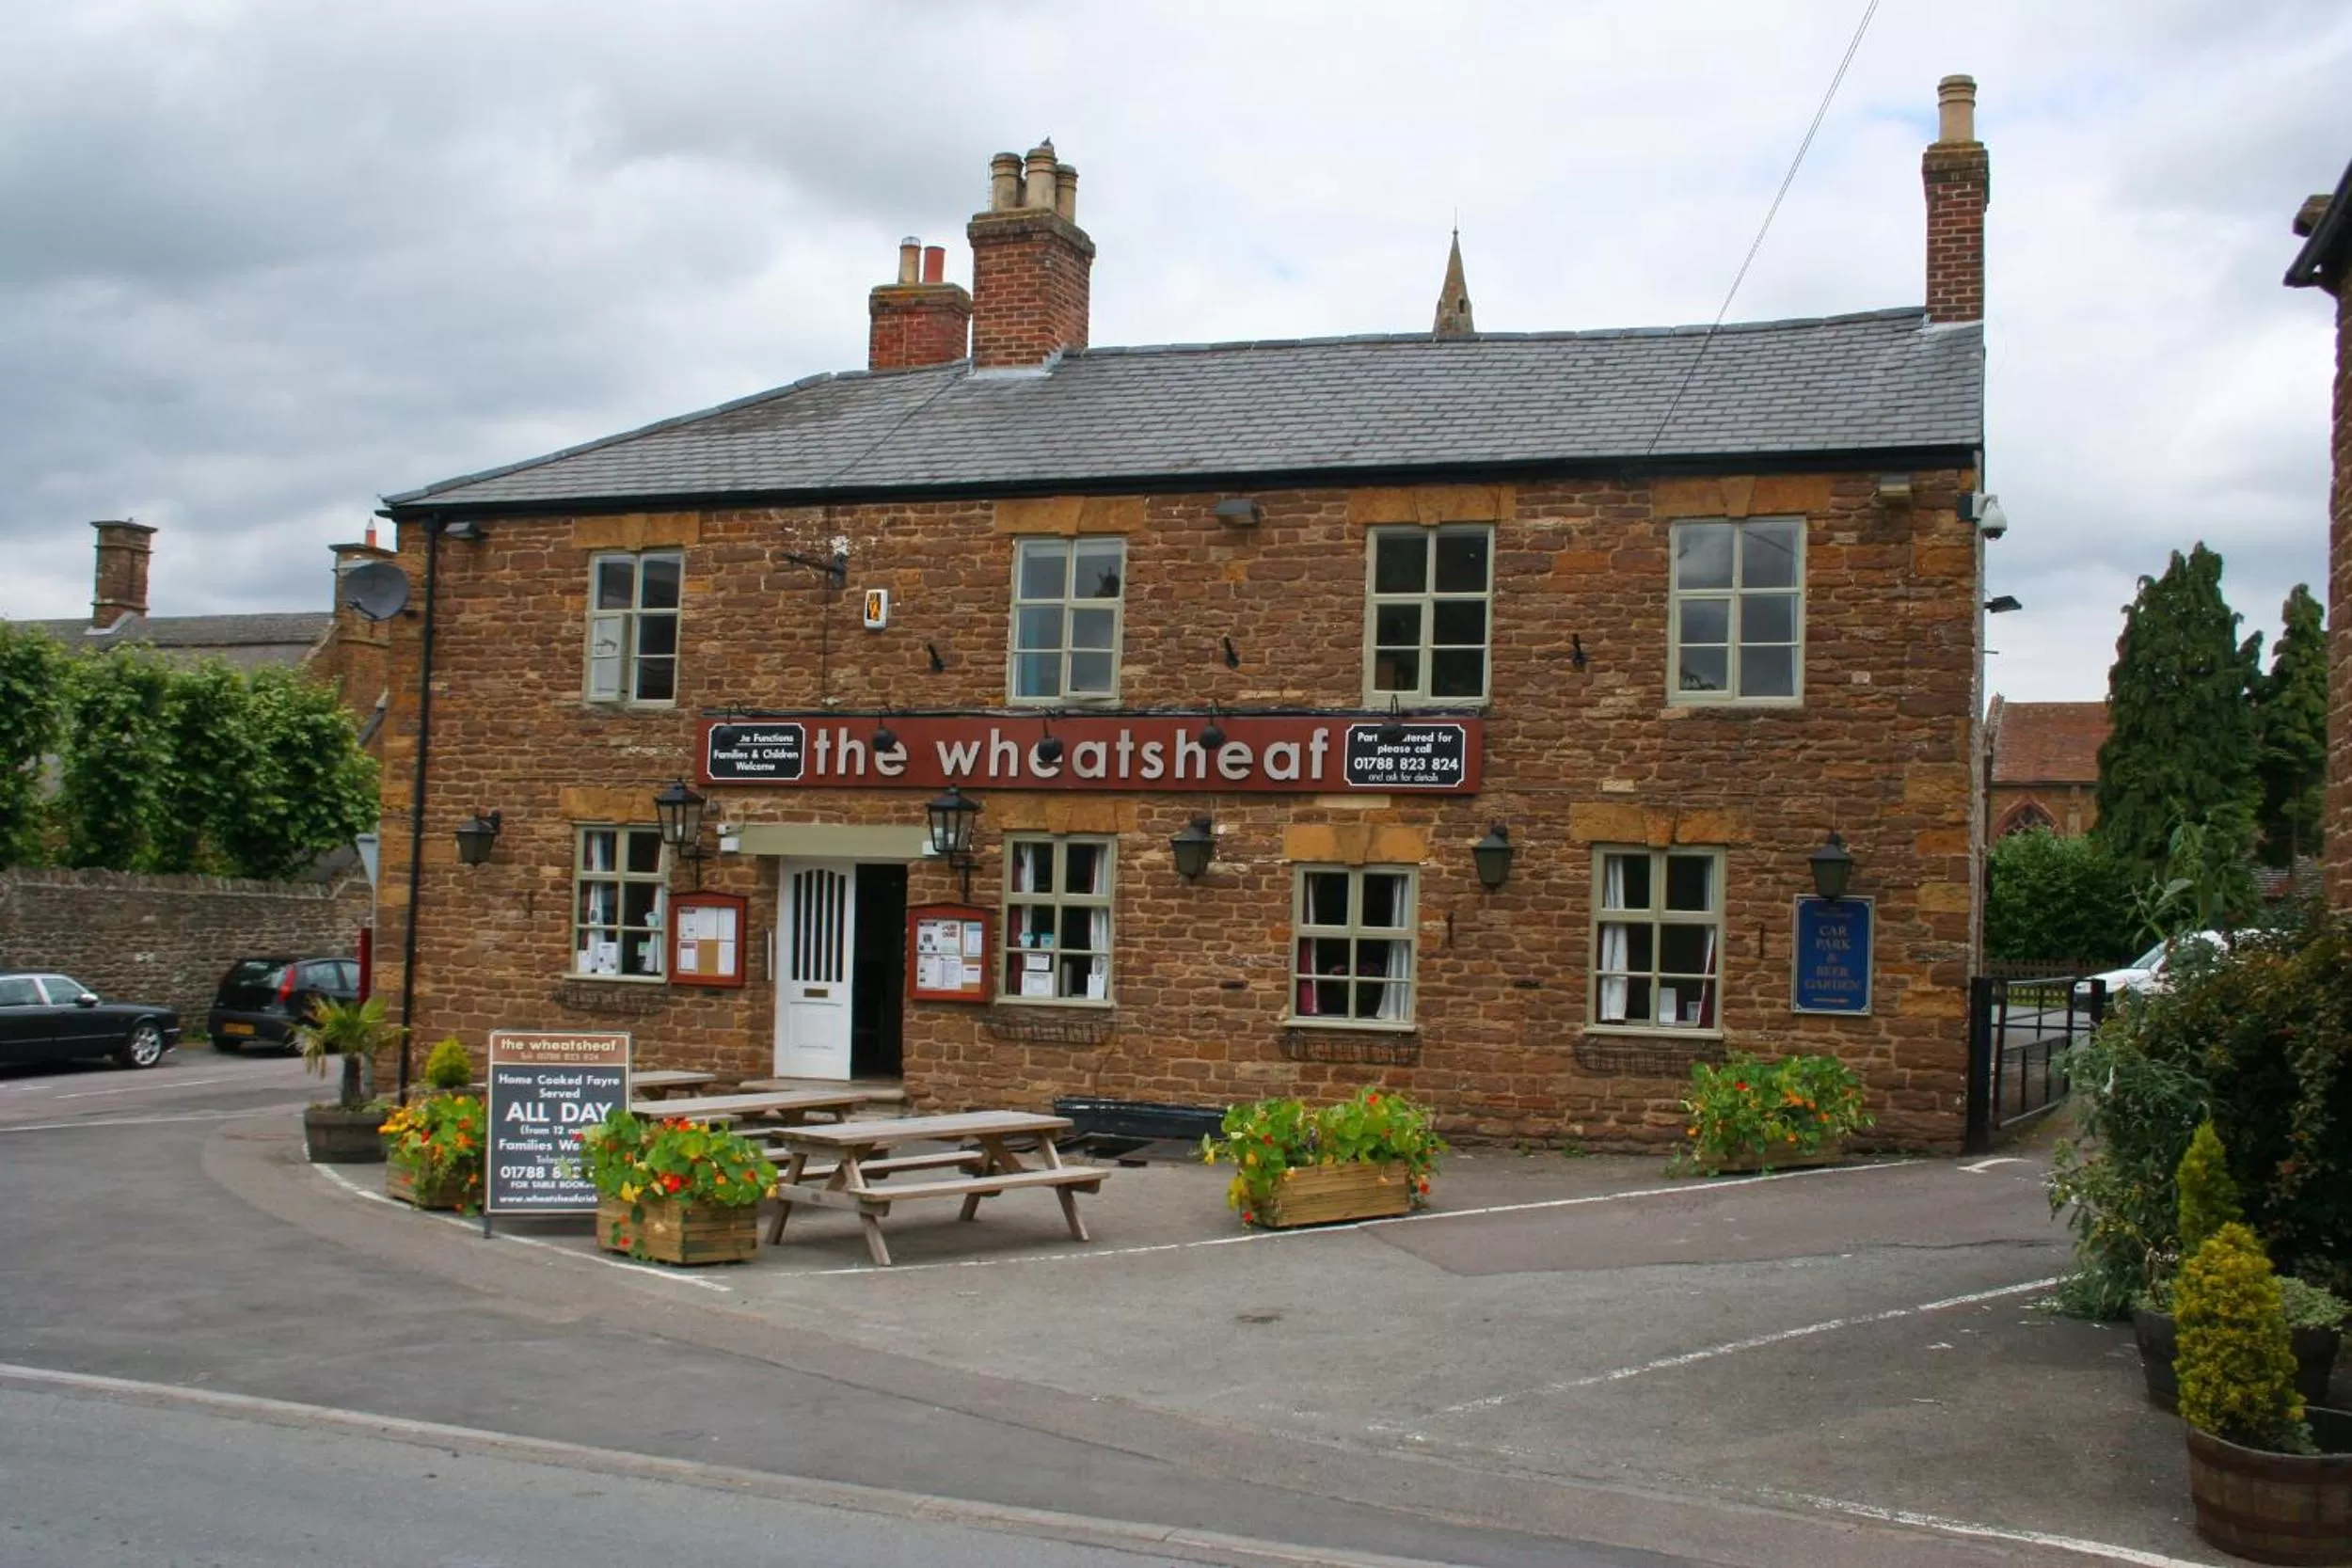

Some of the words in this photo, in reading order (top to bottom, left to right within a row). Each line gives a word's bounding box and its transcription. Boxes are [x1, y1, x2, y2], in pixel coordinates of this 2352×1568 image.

[754, 734, 794, 743] Functions
[1438, 732, 1453, 742] for
[713, 749, 749, 759] Families
[751, 749, 759, 759] &
[763, 749, 799, 759] Children
[814, 727, 908, 776] the
[935, 727, 1329, 781] wheatsheaf
[1377, 744, 1411, 754] please
[1414, 743, 1433, 753] call
[735, 761, 775, 770] Welcome
[1354, 757, 1393, 770] 01788
[1400, 757, 1426, 770] 823
[1431, 757, 1459, 771] 824
[1368, 772, 1384, 782] and
[1386, 772, 1397, 782] ask
[1400, 772, 1412, 782] for
[1414, 772, 1438, 782] details
[1819, 925, 1848, 937] CAR
[1816, 938, 1851, 950] PARK
[501, 1038, 524, 1051] the
[529, 1038, 617, 1052] wheatsheaf
[499, 1073, 532, 1085] Home
[537, 1074, 582, 1085] Cooked
[586, 1074, 620, 1088] Fayre
[539, 1087, 581, 1099] Served
[505, 1101, 550, 1122] ALL
[561, 1101, 612, 1123] DAY
[519, 1125, 549, 1135] (from
[553, 1125, 564, 1135] 12
[499, 1137, 553, 1151] Families
[500, 1165, 546, 1179] 01788
